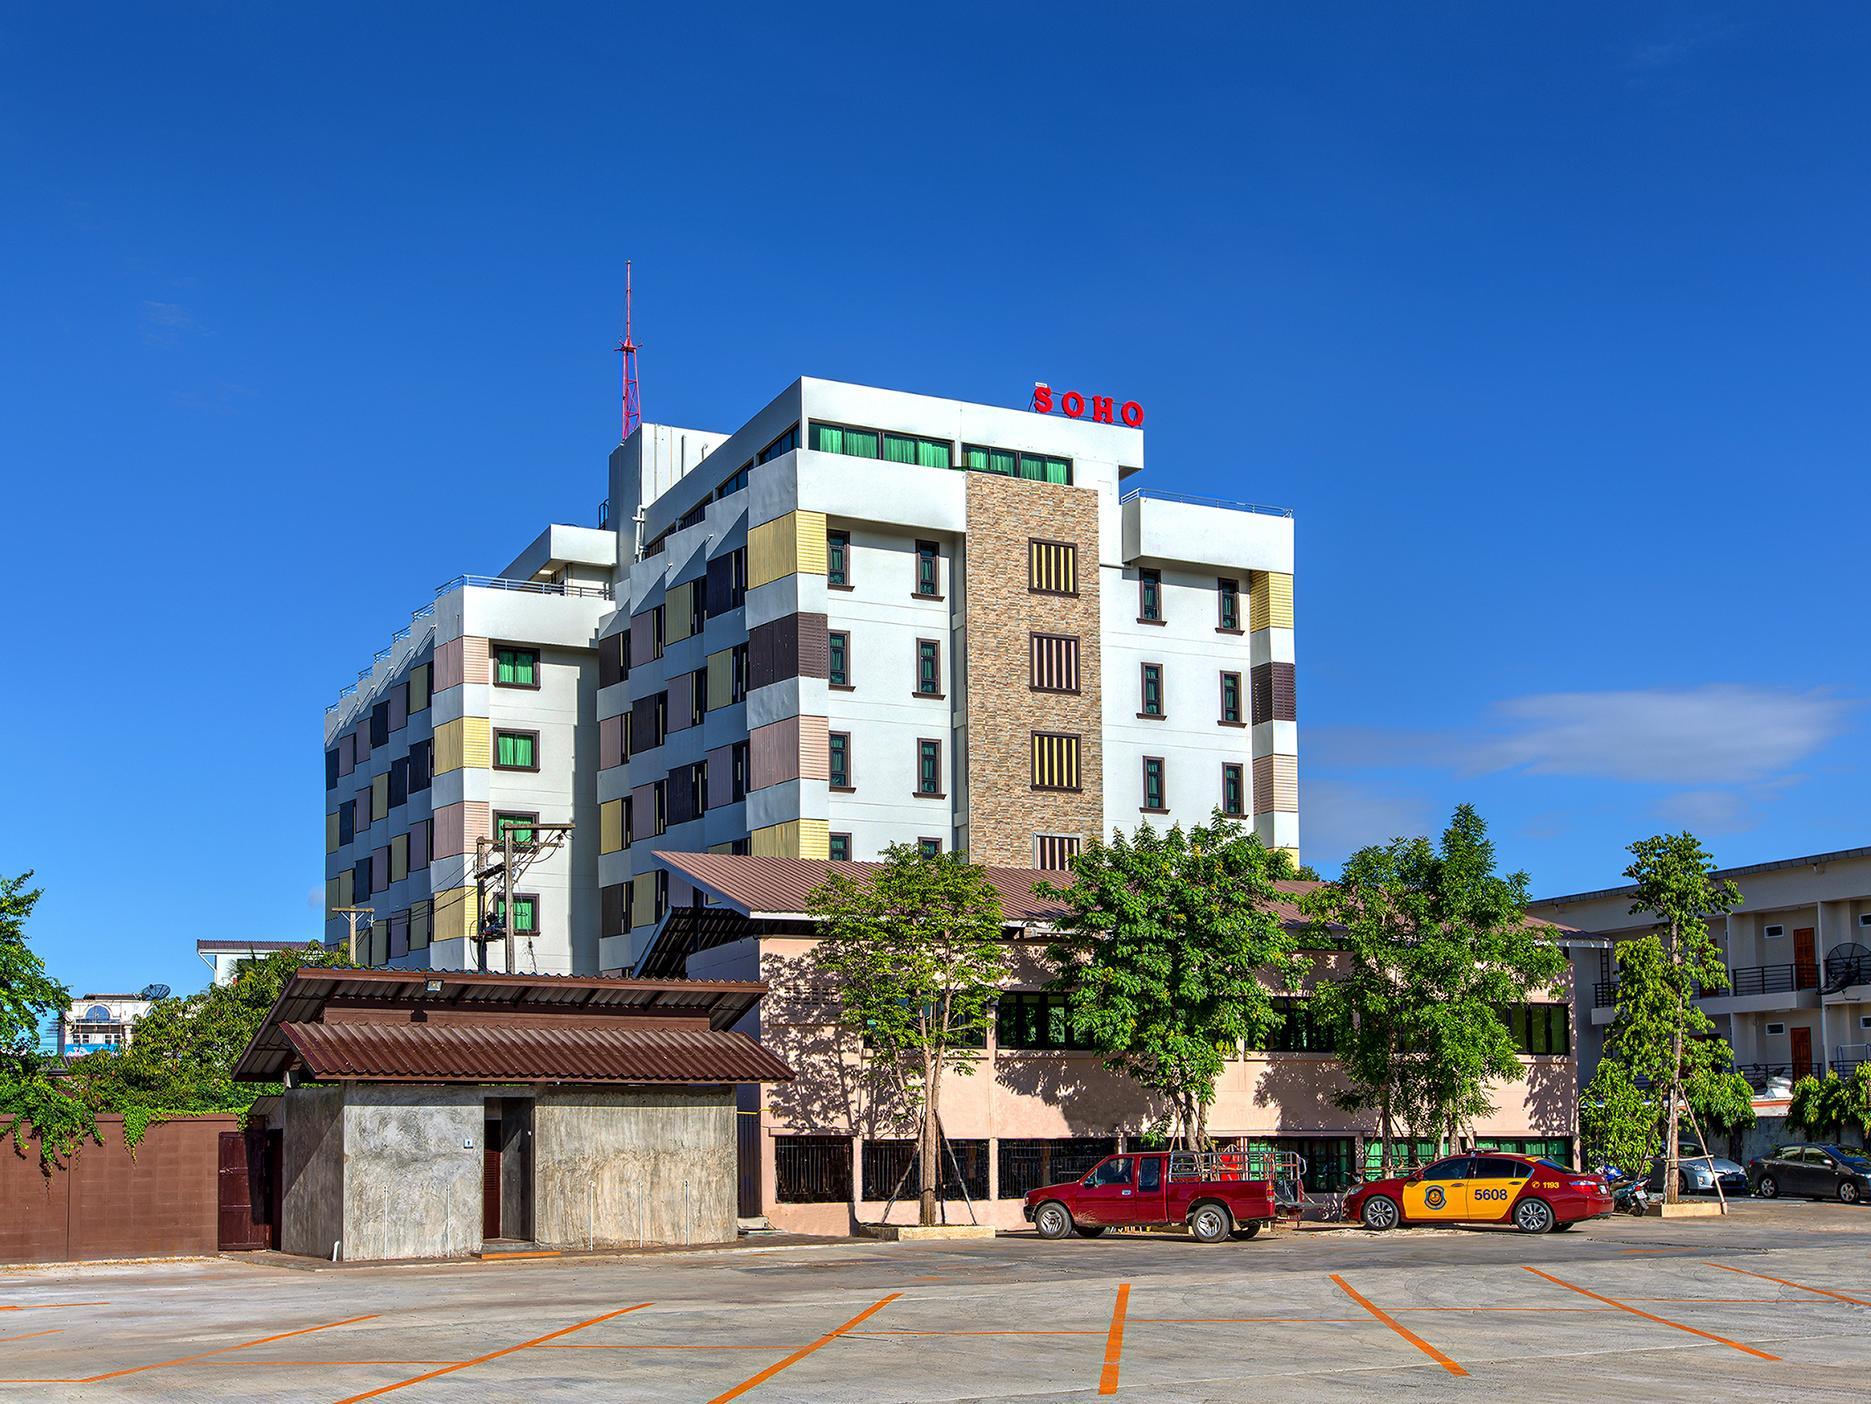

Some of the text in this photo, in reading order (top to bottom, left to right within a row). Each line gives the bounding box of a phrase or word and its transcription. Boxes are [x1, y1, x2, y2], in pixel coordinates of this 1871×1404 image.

[1034, 386, 1144, 428] SOHO
[1543, 1181, 1560, 1189] 1193
[1475, 1188, 1508, 1201] 5608
